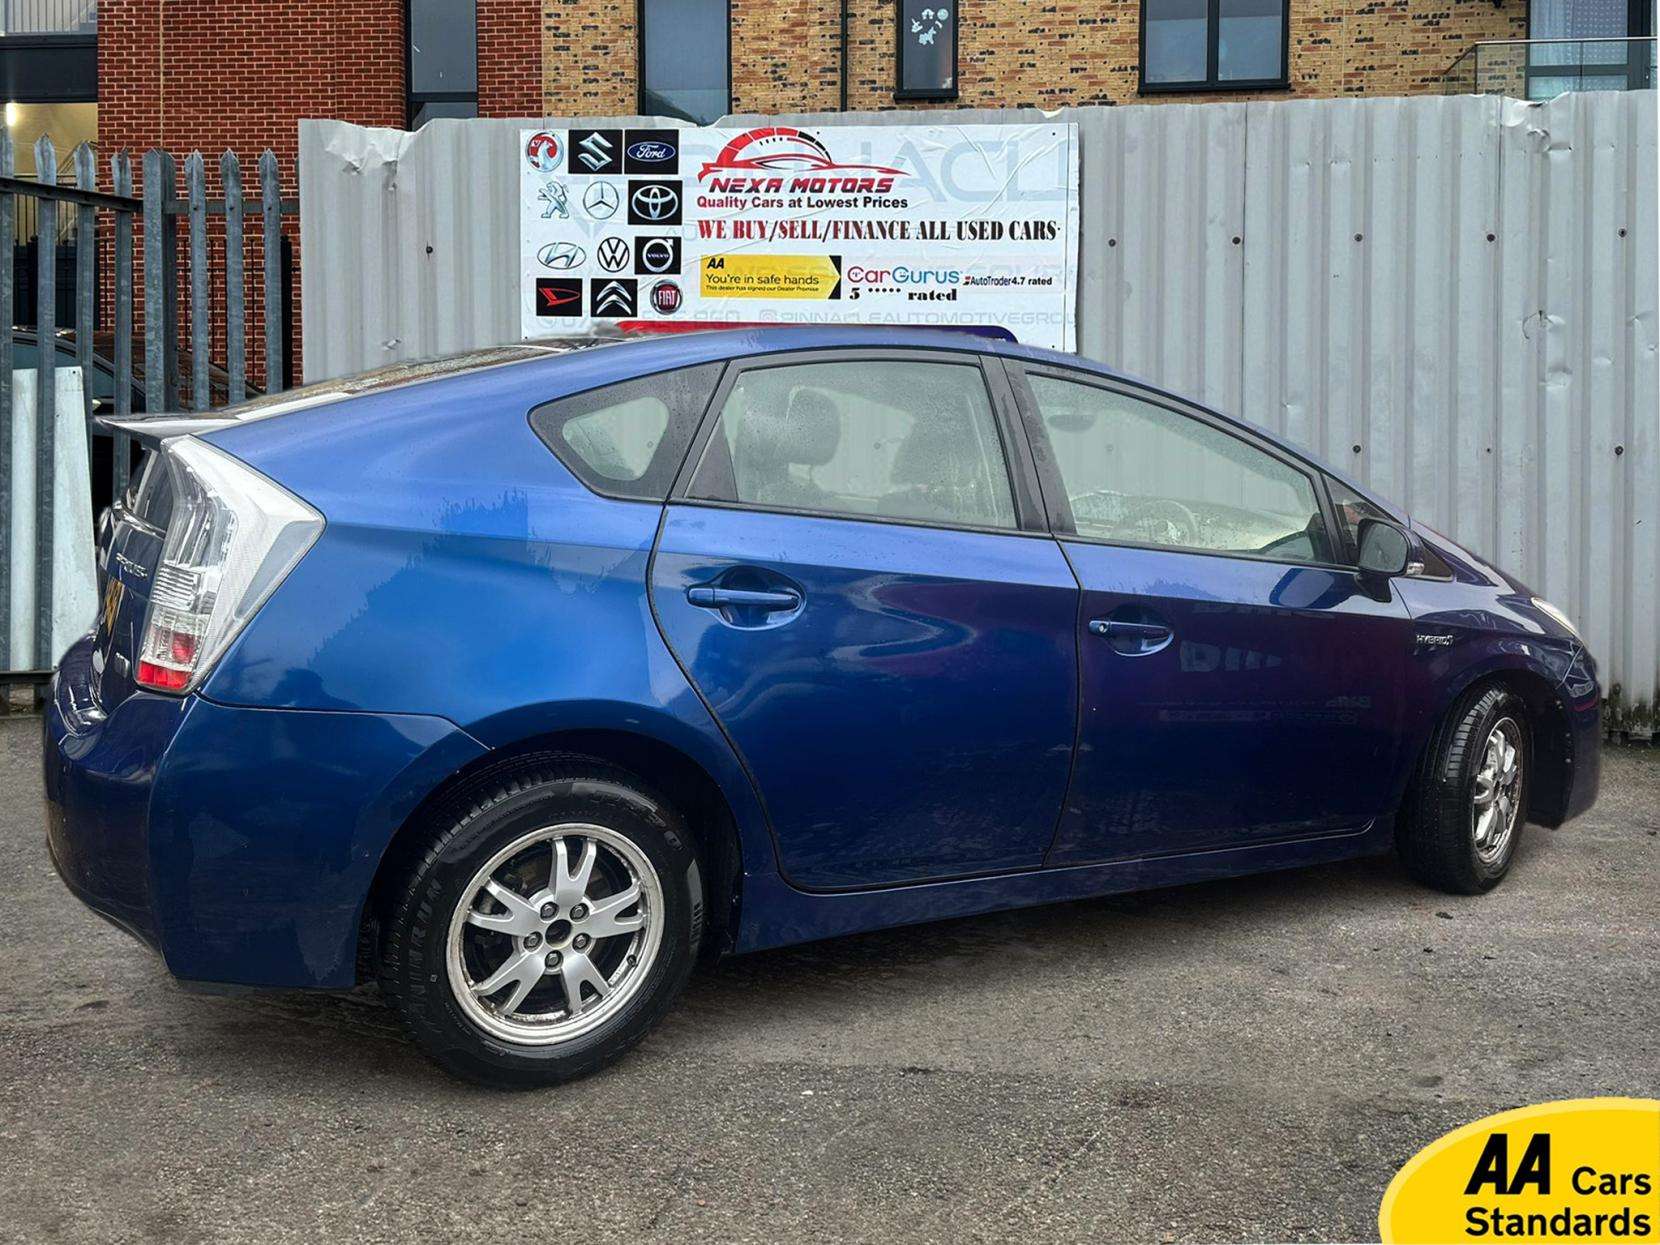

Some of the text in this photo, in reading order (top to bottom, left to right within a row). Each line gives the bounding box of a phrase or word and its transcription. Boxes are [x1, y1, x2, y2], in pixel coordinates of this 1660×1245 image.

[636, 143, 666, 159] Ford
[708, 177, 895, 194] NEXA MOTORS
[697, 196, 909, 210] Quality Cars at Lowest Prices
[697, 219, 727, 240] WE
[915, 220, 951, 241] ALL
[956, 220, 1004, 241] USED
[706, 257, 725, 270] AA
[706, 273, 820, 286] You're in safe hands
[847, 265, 960, 284] CarGurus
[970, 275, 1052, 287] AutoTrader 4.7 rated
[658, 290, 676, 306] FIAT
[849, 287, 957, 301] 5 rated
